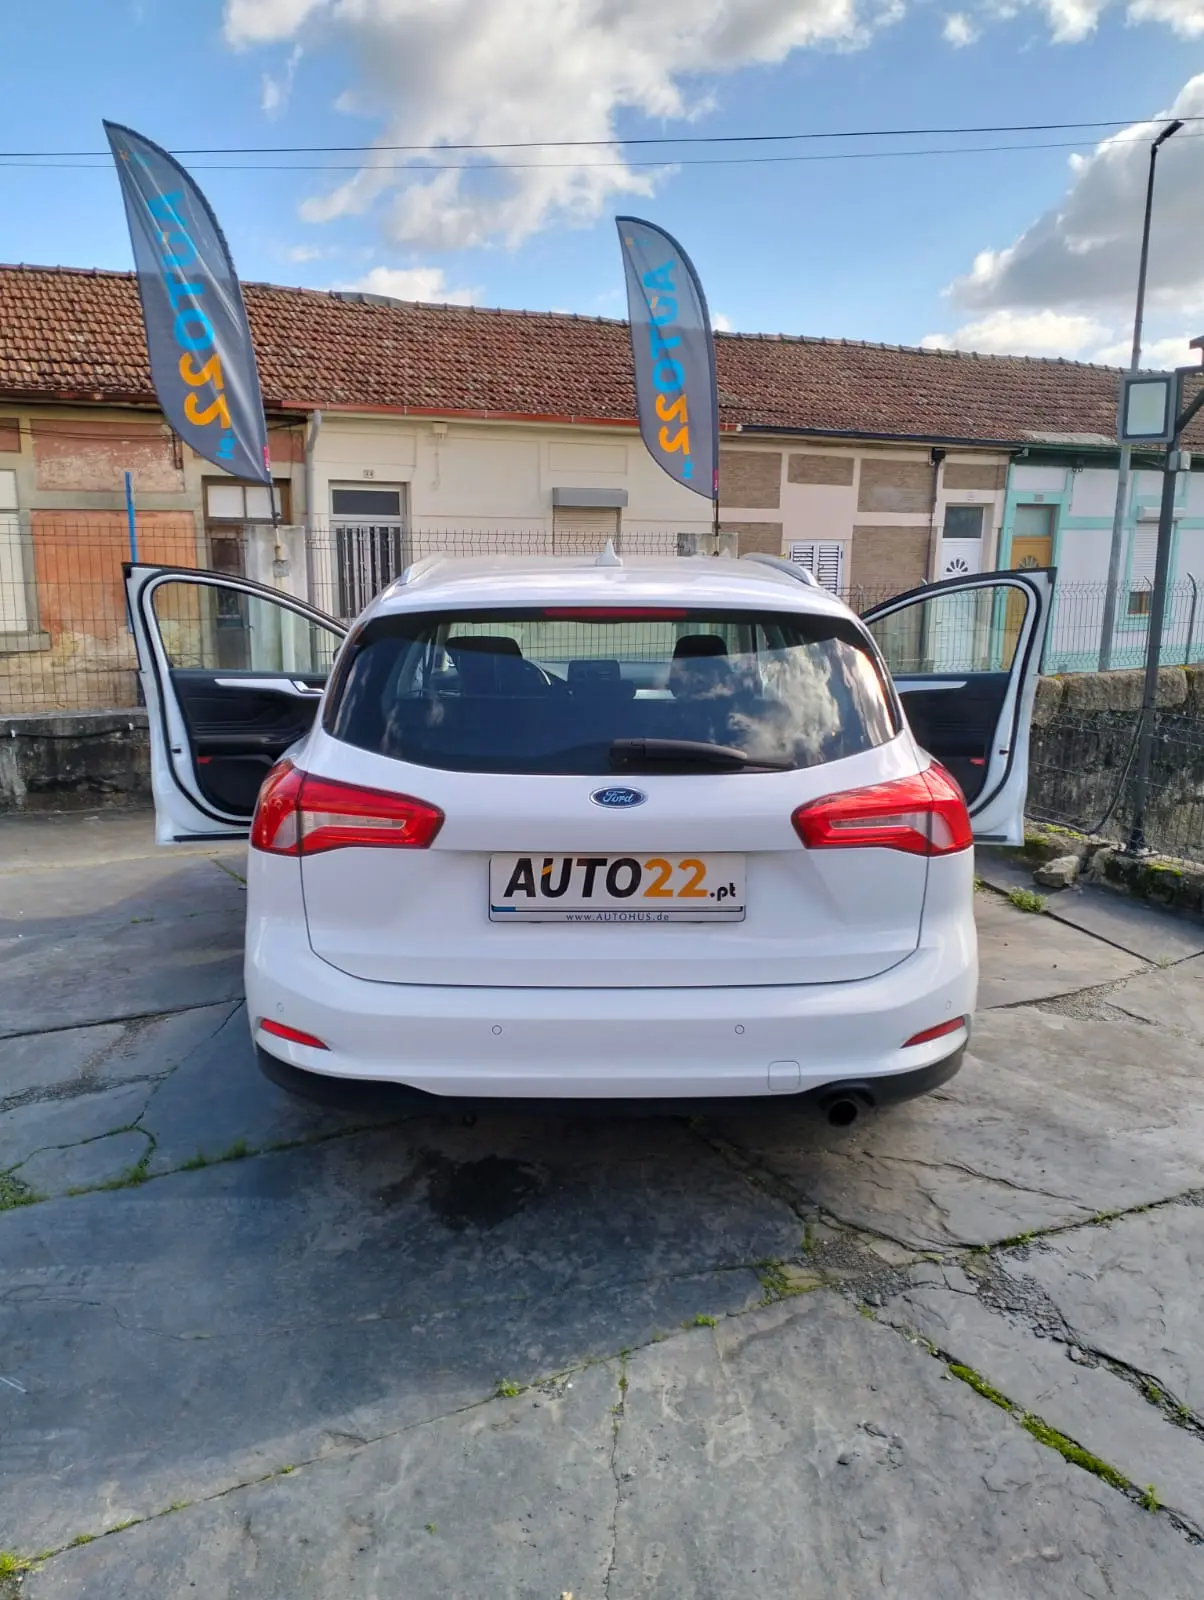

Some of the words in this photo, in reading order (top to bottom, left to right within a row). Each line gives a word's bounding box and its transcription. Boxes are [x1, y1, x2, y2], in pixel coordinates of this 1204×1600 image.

[603, 790, 633, 803] Ford
[503, 857, 736, 901] AUTO22.pt
[566, 911, 669, 922] www.AUTOHUS.de
